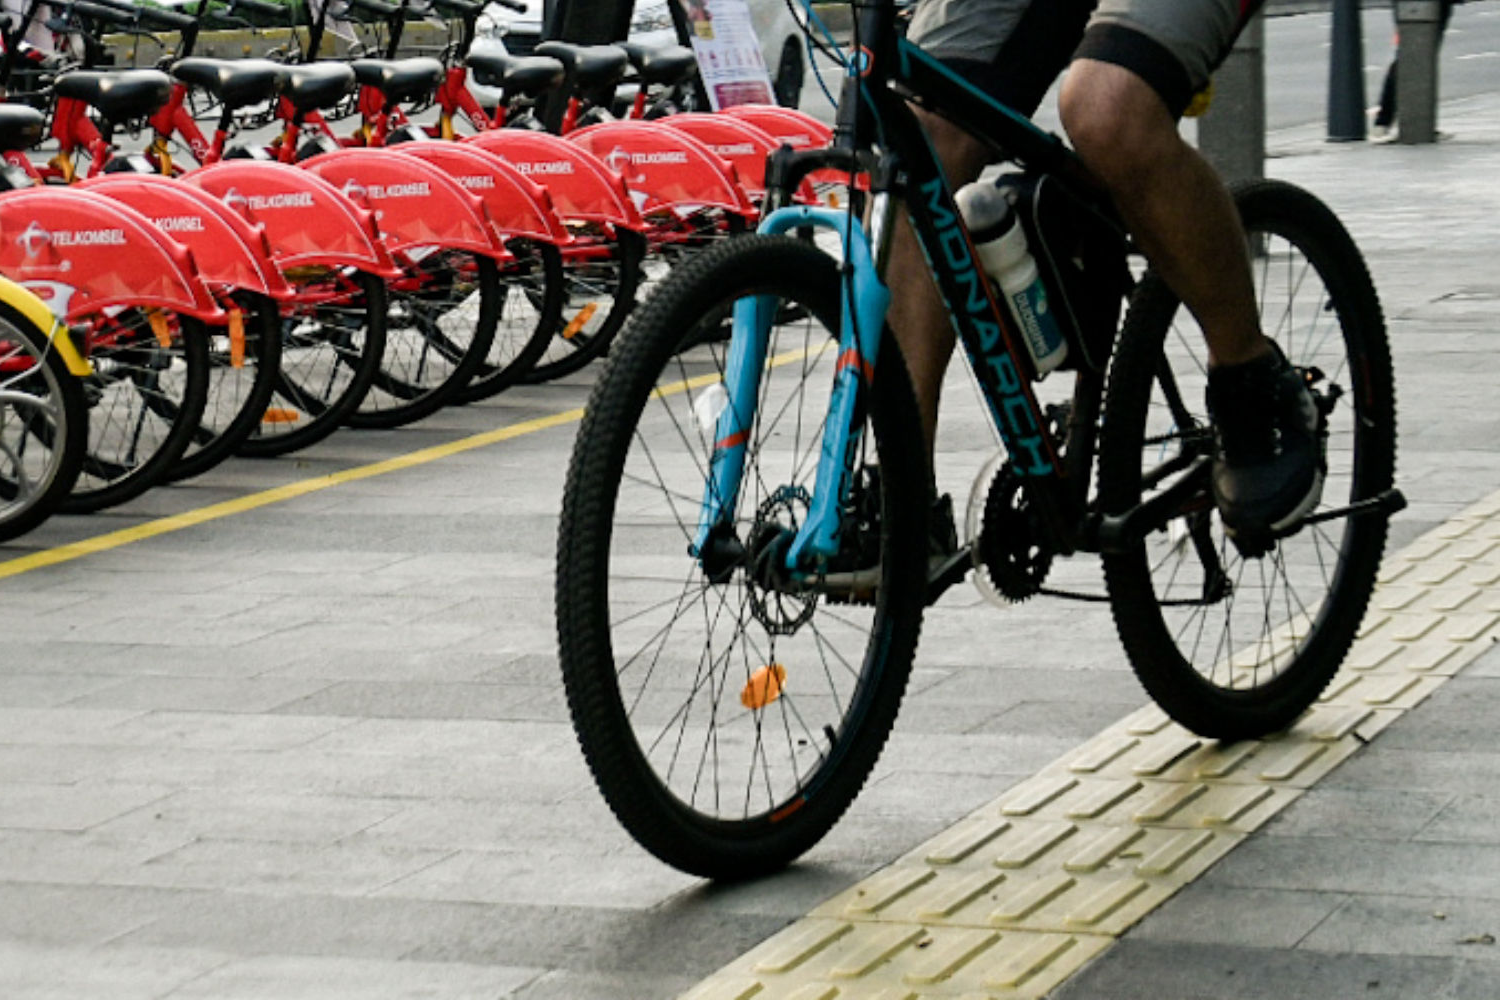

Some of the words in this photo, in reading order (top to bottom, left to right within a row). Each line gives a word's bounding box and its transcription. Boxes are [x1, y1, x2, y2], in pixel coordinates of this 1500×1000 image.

[367, 182, 431, 199] TELKOMSEL
[248, 192, 315, 210] TELKOMSEL
[51, 228, 127, 247] TELKOMSEL
[920, 176, 1053, 477] MONARCH
